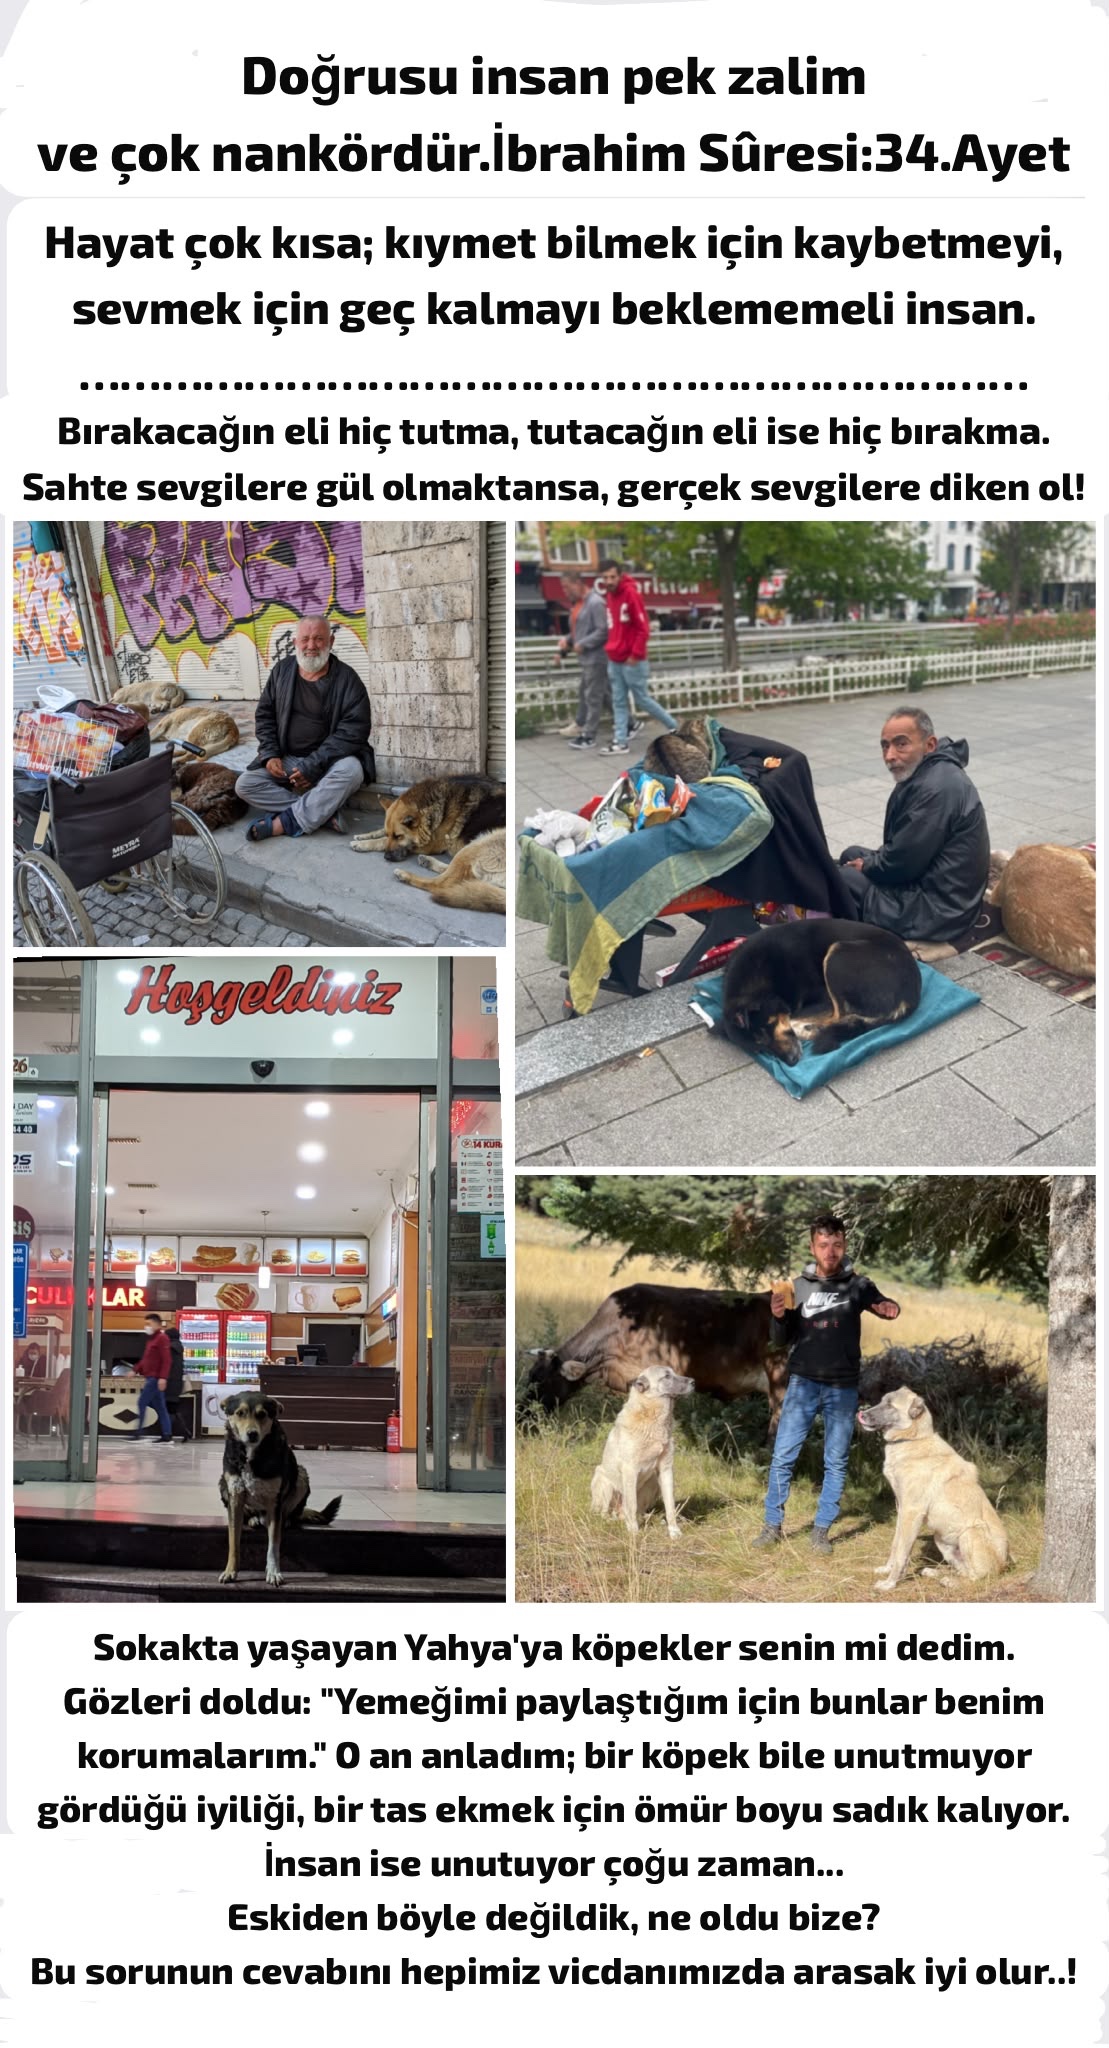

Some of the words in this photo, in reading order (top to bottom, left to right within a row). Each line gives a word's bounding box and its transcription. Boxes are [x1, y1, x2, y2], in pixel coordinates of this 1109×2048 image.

[112, 837, 140, 854] MEYRA
[124, 964, 402, 1025] Hoşgeldiniz
[807, 1292, 839, 1306] NIKE
